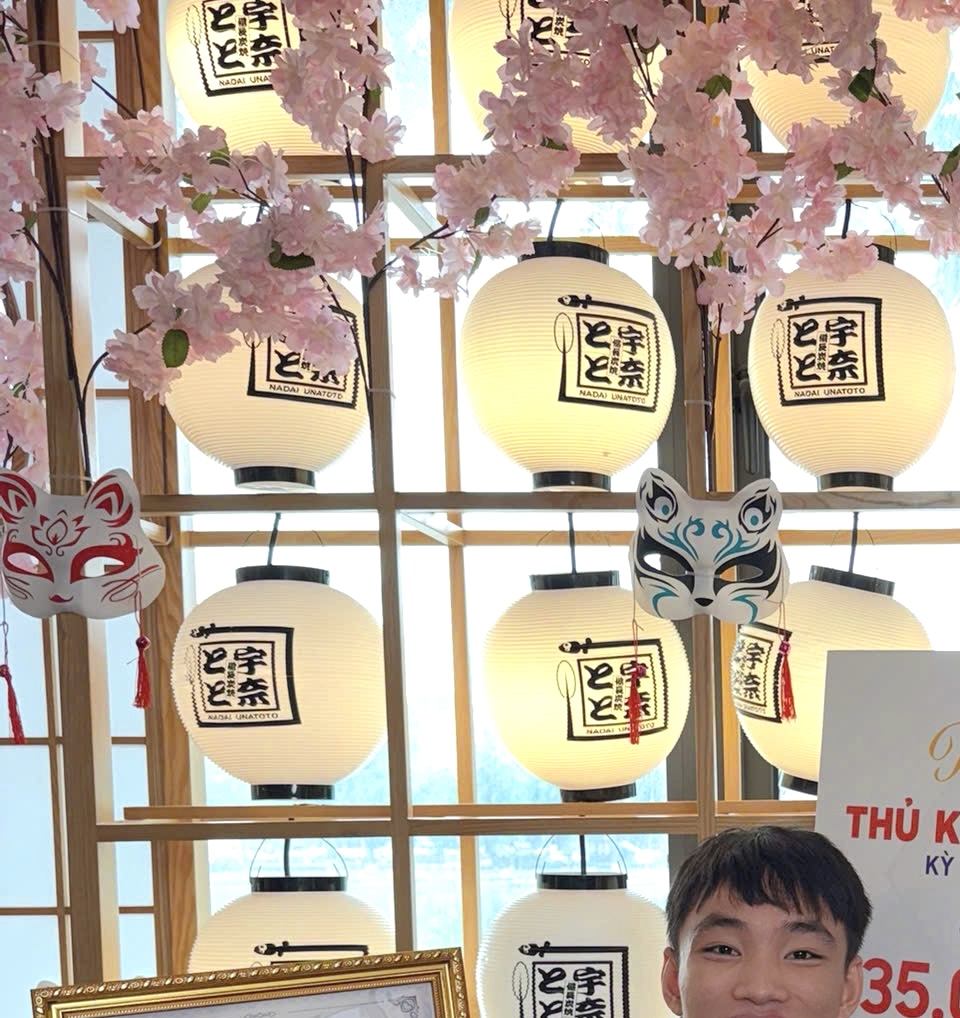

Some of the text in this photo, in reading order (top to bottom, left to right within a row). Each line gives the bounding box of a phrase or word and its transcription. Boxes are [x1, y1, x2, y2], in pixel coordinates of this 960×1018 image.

[219, 78, 246, 87] NADAI
[269, 384, 343, 399] NADAI UNATOTO
[579, 389, 647, 404] NADAI UNATOTO
[794, 387, 866, 398] NADAI UNATOTO
[846, 797, 920, 842] THỦ
[925, 850, 954, 877] KỲ
